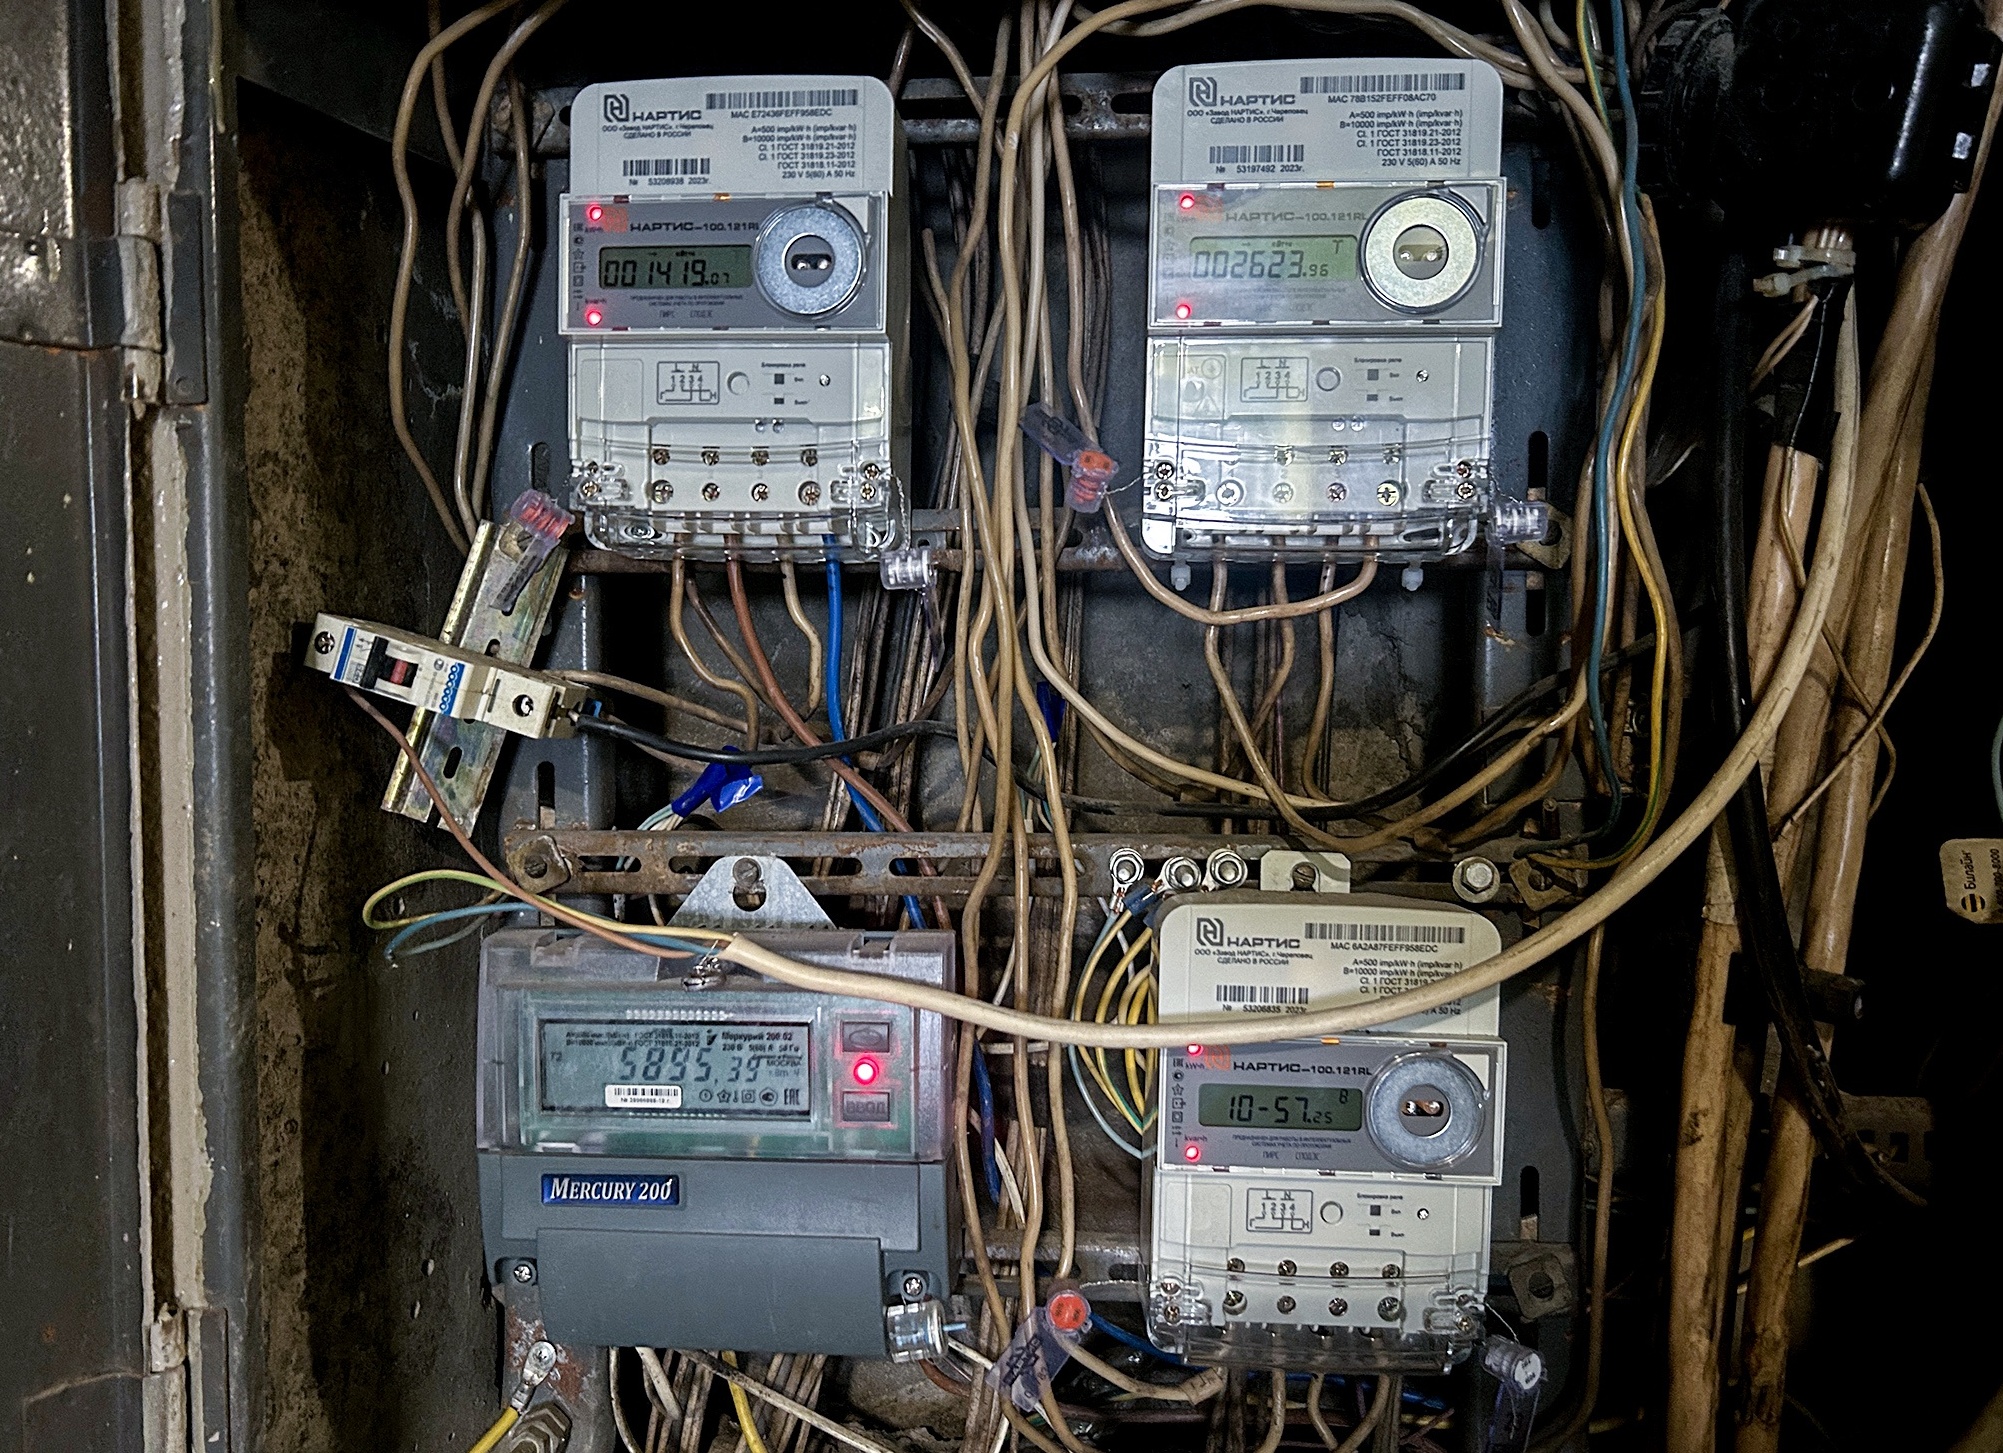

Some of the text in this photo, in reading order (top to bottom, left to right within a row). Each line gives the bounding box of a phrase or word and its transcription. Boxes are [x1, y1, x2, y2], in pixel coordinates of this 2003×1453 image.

[1220, 95, 1296, 106] НАРТИС
[1328, 95, 1348, 103] MAC
[633, 110, 702, 122] НАРТИС
[1349, 111, 1375, 119] A=500
[1377, 129, 1401, 137] ГОСТ
[1402, 128, 1461, 137] 31819.21-2012
[1377, 139, 1401, 147] ГОСТ
[1402, 138, 1461, 146] 31819.23-2012
[777, 143, 799, 151] ГОСТ
[777, 152, 799, 160] ГОСТ
[1402, 148, 1461, 156] 31818.11-2012
[1407, 158, 1428, 167] 5(60)
[1236, 165, 1276, 173] 53197492
[782, 171, 796, 179] 230
[648, 178, 684, 186] 53208938
[1192, 250, 1329, 278] 002623.96
[1960, 851, 1977, 890] Билайн
[1227, 937, 1300, 949] НАРТИС
[1331, 942, 1350, 950] MAC
[1344, 967, 1377, 975] B=10000
[1243, 1005, 1280, 1013] 53206835
[1439, 1006, 1448, 1014] 50
[1450, 1007, 1461, 1015] Hz
[1229, 1095, 1332, 1123] 10-57.25
[550, 1178, 673, 1200] MERCURY 200
